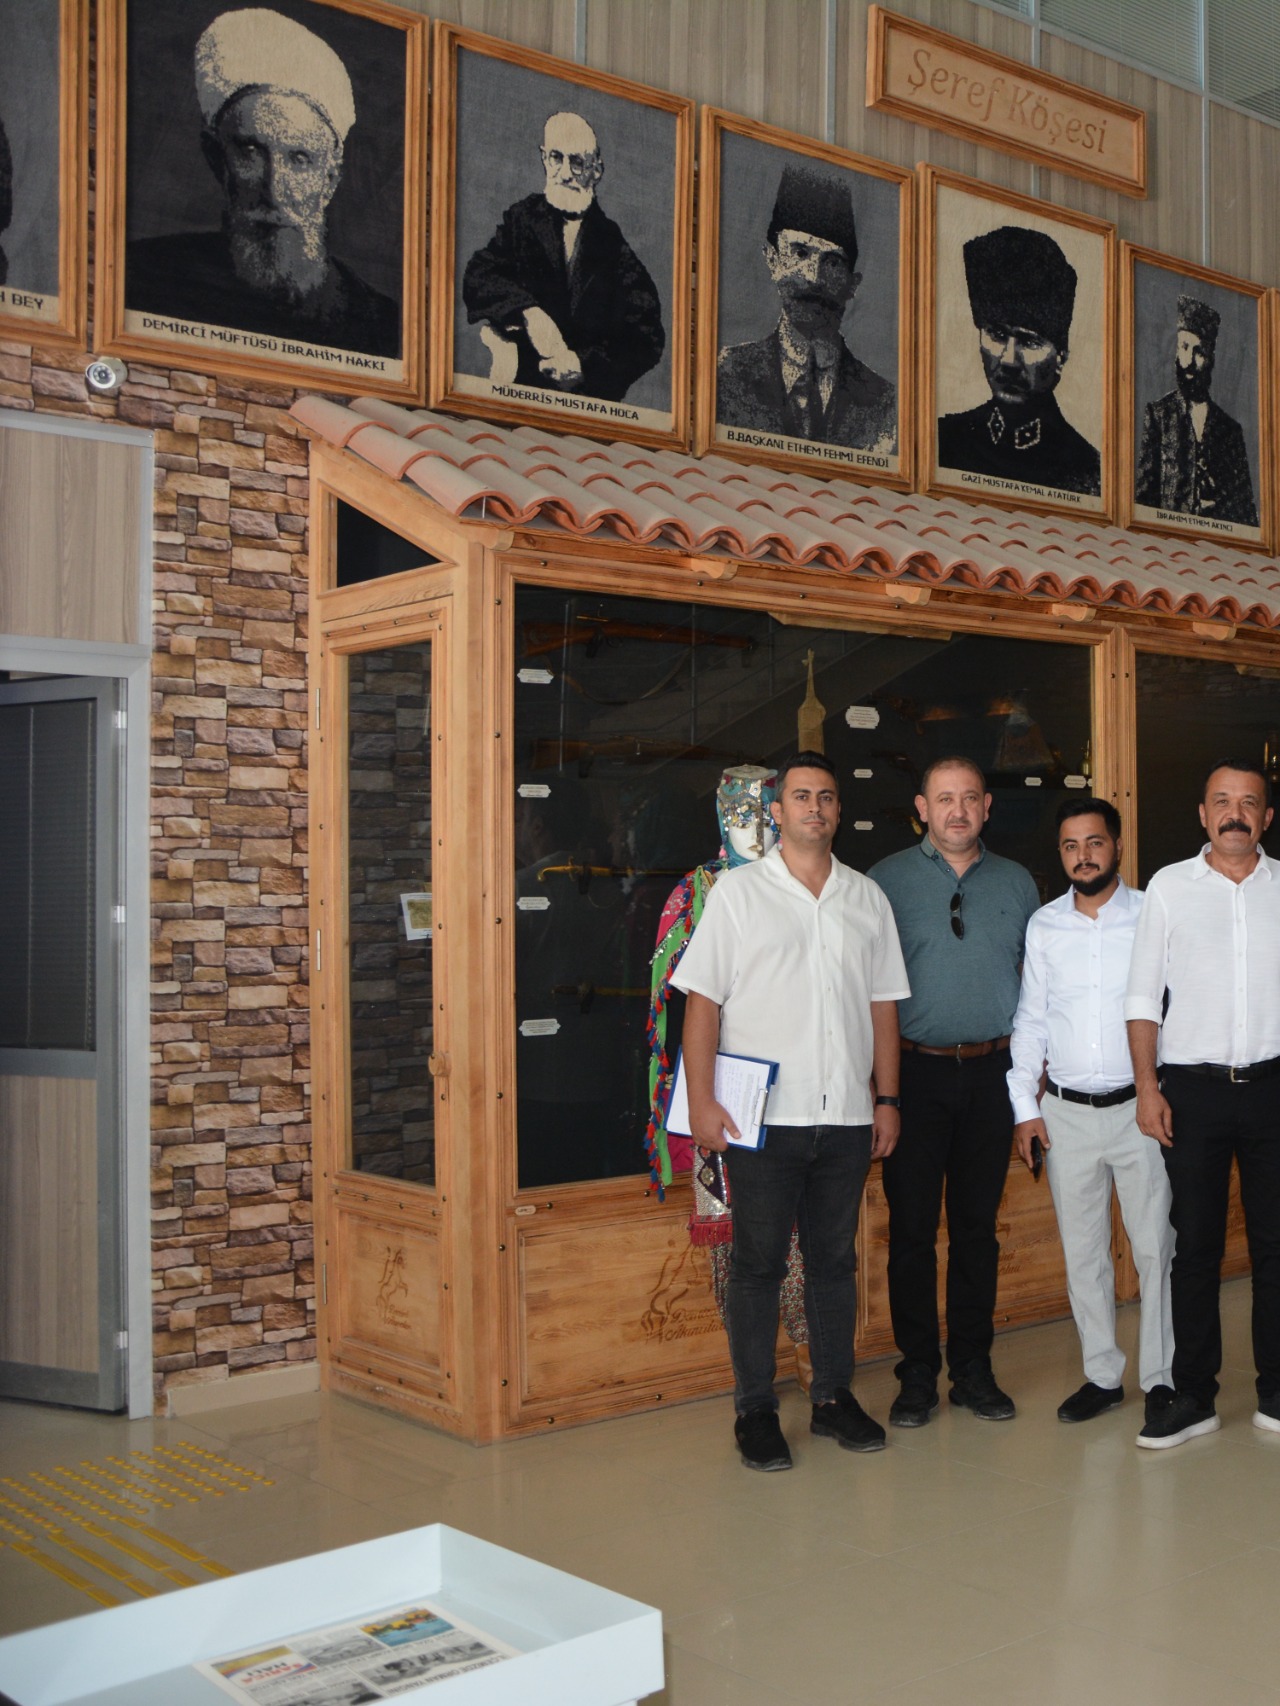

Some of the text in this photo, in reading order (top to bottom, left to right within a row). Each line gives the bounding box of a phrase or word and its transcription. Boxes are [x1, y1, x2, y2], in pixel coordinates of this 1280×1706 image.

[907, 48, 1107, 154] Şeref Köşesi
[12, 293, 43, 310] BEY
[143, 318, 386, 371] DEMİRCİ MÜFTÜSÜ İBRAHİM HAKKI
[491, 385, 640, 421] MÜDERRİS MUSTAFA HOCA
[787, 441, 822, 456] ETHEM
[823, 449, 854, 463] FEHMİ
[856, 454, 889, 468] EFENDİ
[961, 473, 1081, 503] GAZİ MUSTAFA KEMAL ATATÜRK
[1189, 518, 1210, 527] ETHEM
